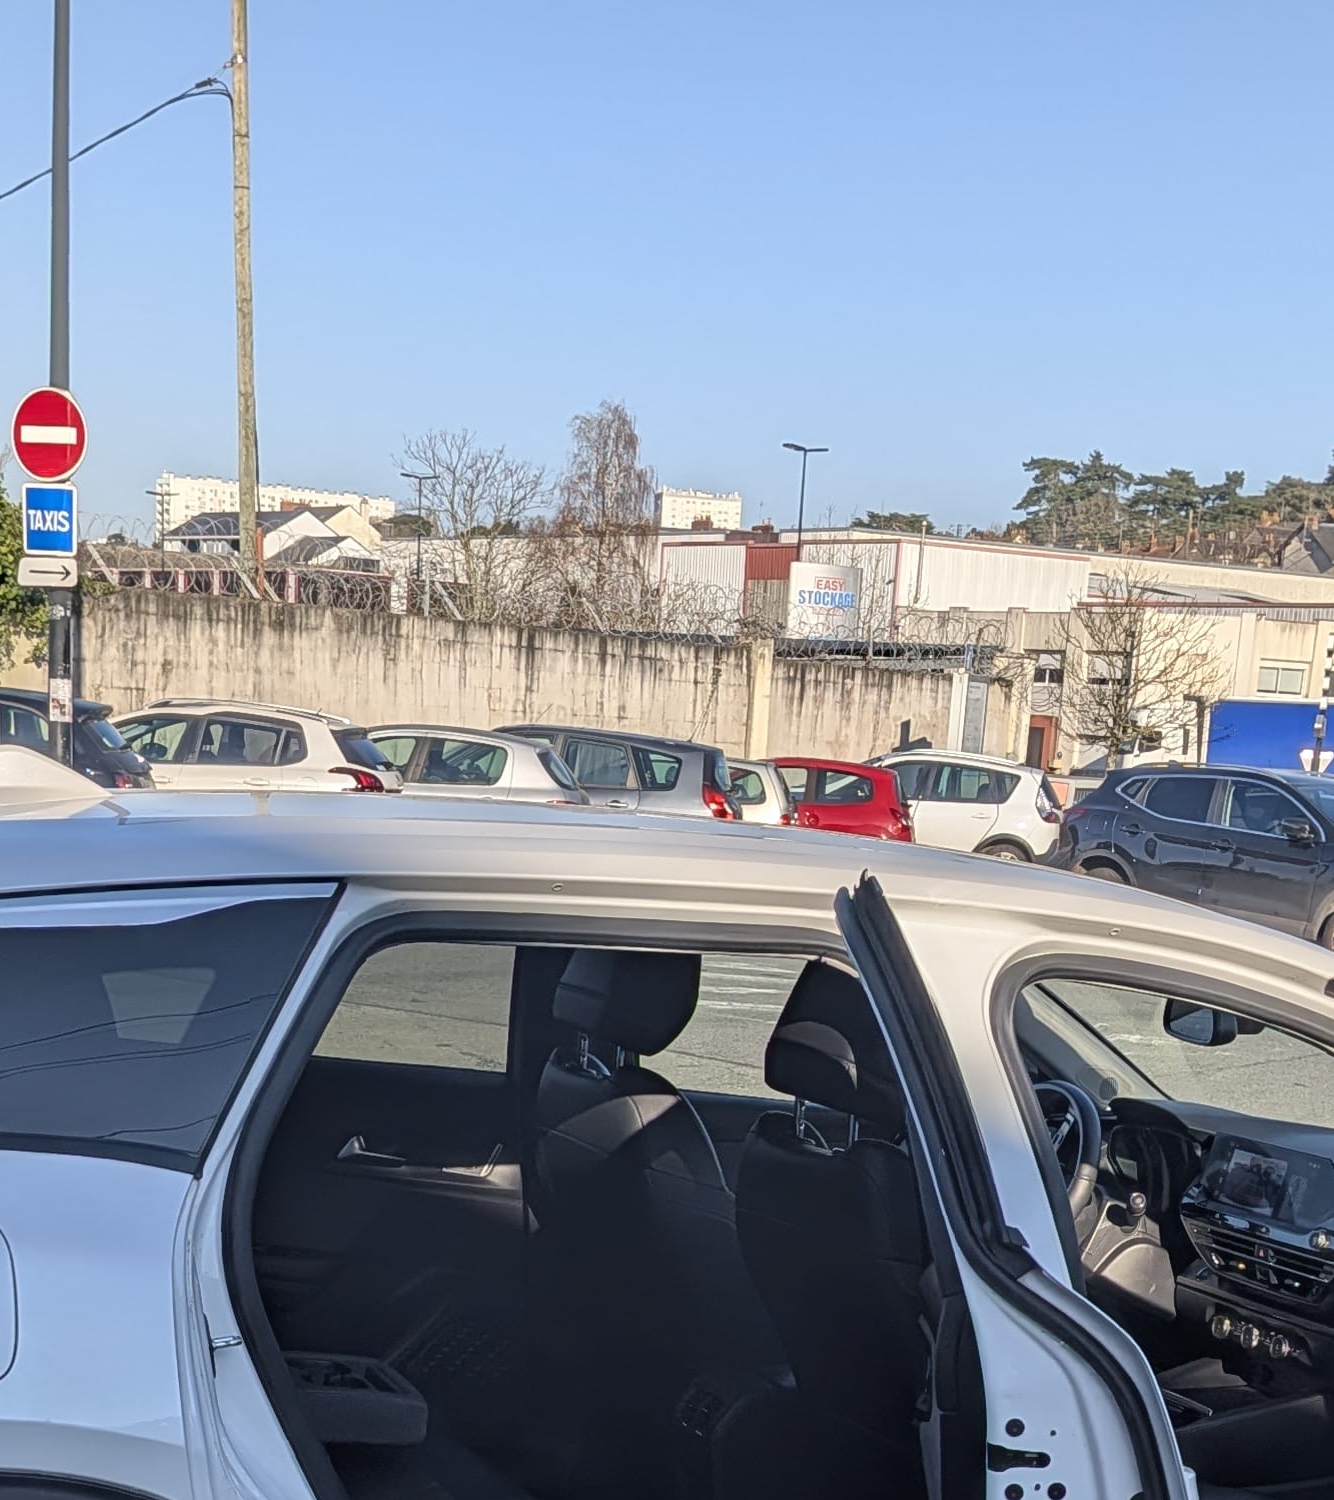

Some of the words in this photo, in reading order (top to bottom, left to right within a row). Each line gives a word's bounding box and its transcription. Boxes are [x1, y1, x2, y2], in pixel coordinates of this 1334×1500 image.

[27, 509, 70, 532] TAXIS
[816, 579, 845, 592] EASY
[798, 590, 856, 608] STOCKAGE
